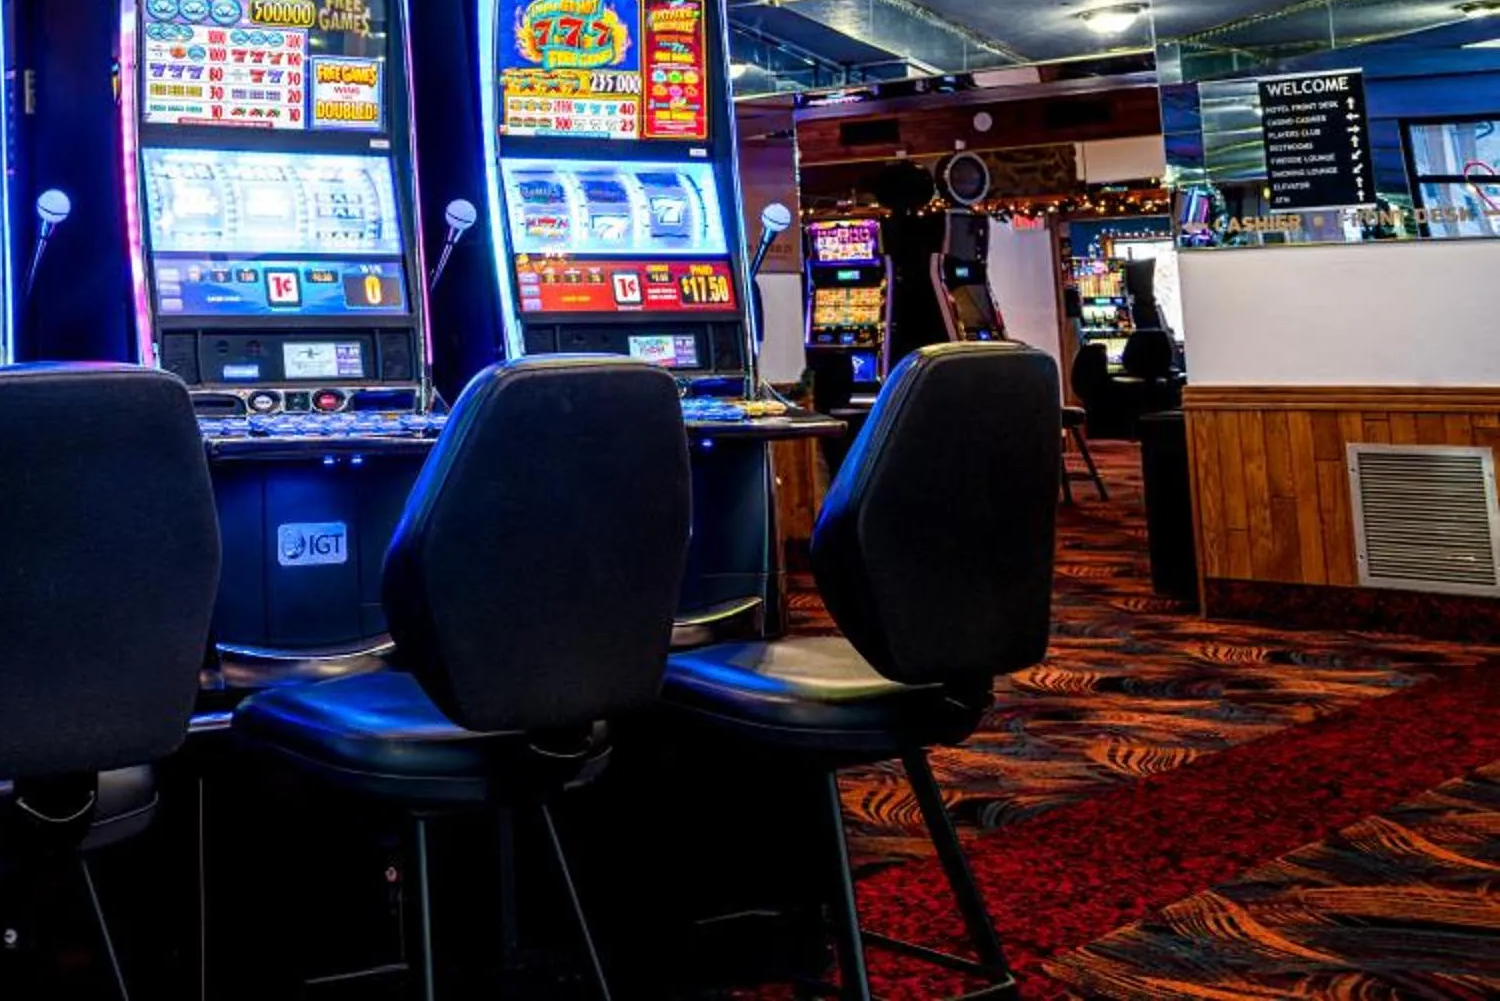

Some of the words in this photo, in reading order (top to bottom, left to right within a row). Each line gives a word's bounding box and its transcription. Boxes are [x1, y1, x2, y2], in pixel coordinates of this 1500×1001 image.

[287, 90, 301, 104] 20
[1266, 76, 1349, 97] WELCOME
[211, 105, 224, 119] 10
[288, 108, 301, 122] 10
[1214, 213, 1301, 233] CASHIER
[271, 277, 292, 298] 1¢
[364, 275, 382, 305] 0
[309, 533, 343, 556] IGT
